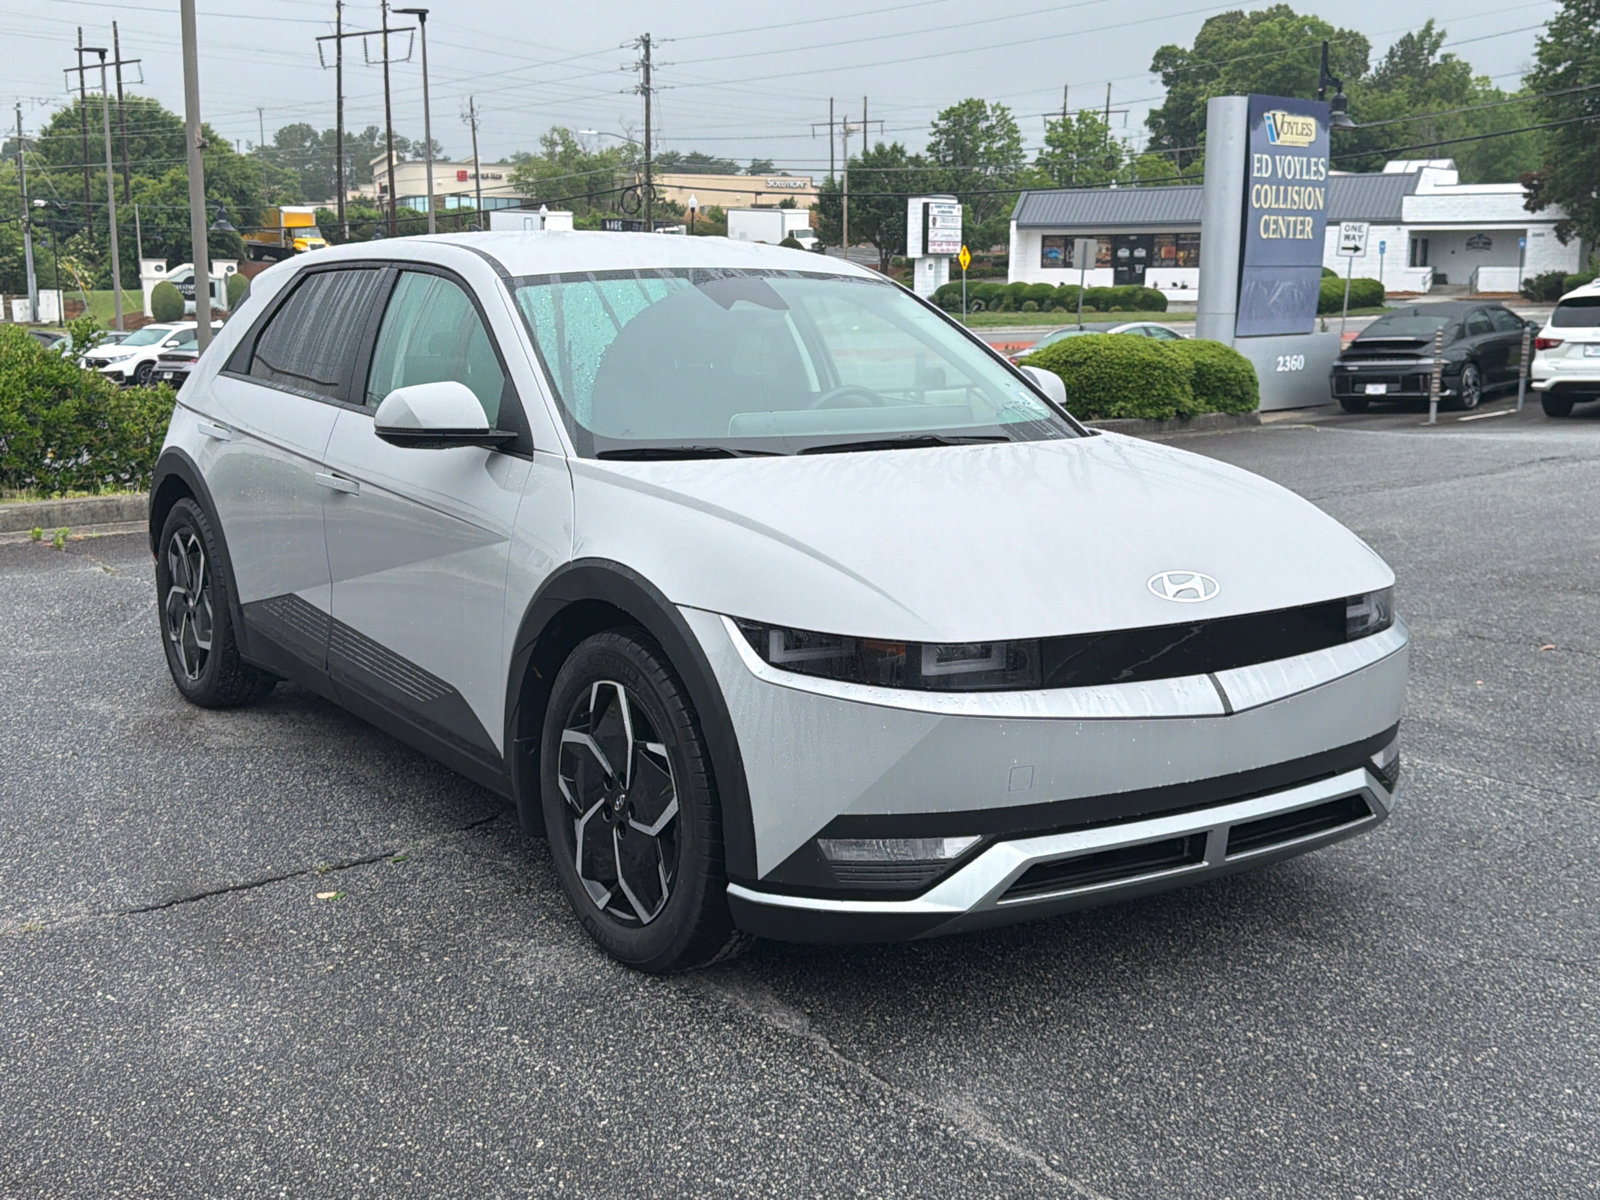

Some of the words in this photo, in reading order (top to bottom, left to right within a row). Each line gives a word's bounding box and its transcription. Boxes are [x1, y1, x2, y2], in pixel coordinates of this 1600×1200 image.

[1272, 113, 1313, 140] VOYLES
[1252, 153, 1273, 178] ED
[1275, 155, 1326, 182] VOYLES
[1251, 184, 1325, 211] COLLISION
[1259, 215, 1314, 240] CENTER
[1344, 224, 1364, 233] ONE
[1344, 234, 1364, 242] WAY
[1276, 354, 1305, 372] 2360
